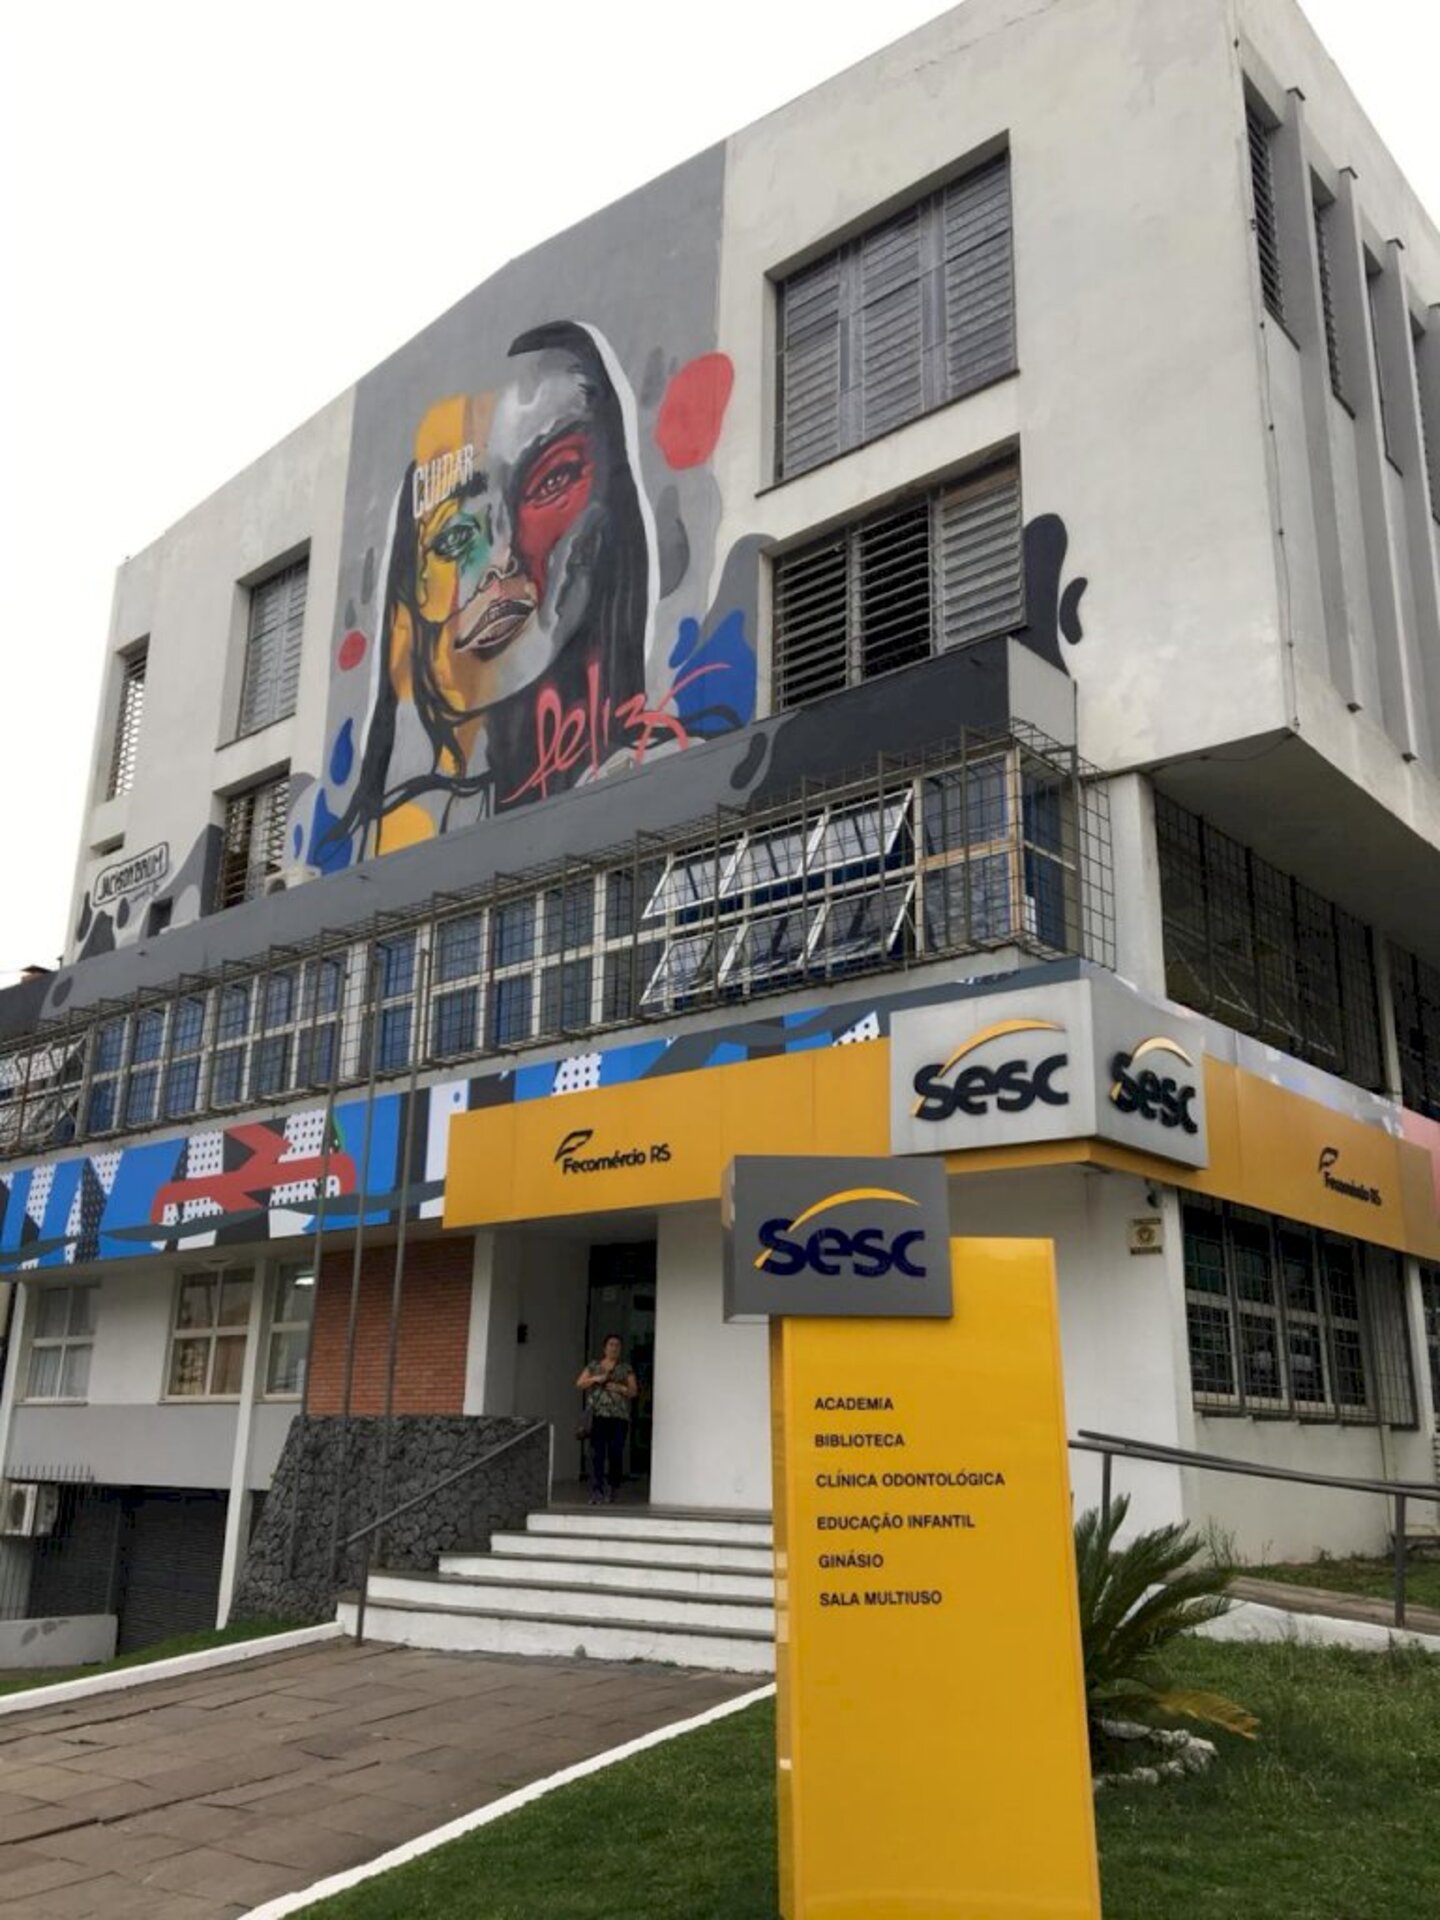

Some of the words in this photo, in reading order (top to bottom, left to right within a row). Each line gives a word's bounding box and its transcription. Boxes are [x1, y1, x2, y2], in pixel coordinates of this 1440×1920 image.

[562, 1150, 647, 1175] Fecomércio
[649, 1143, 672, 1164] RS
[814, 1396, 894, 1411] ACADEMIA
[814, 1433, 905, 1448] BIBLIOTECA
[816, 1468, 878, 1488] CLÍNICA
[881, 1470, 1006, 1488] ODONTOLÓGICA
[816, 1511, 904, 1532] EDUCAÇÃO
[907, 1513, 976, 1529] INFANTIL
[818, 1549, 884, 1569] GINÁSIO
[819, 1592, 861, 1607] SALA
[863, 1590, 943, 1606] MULTIUSO
